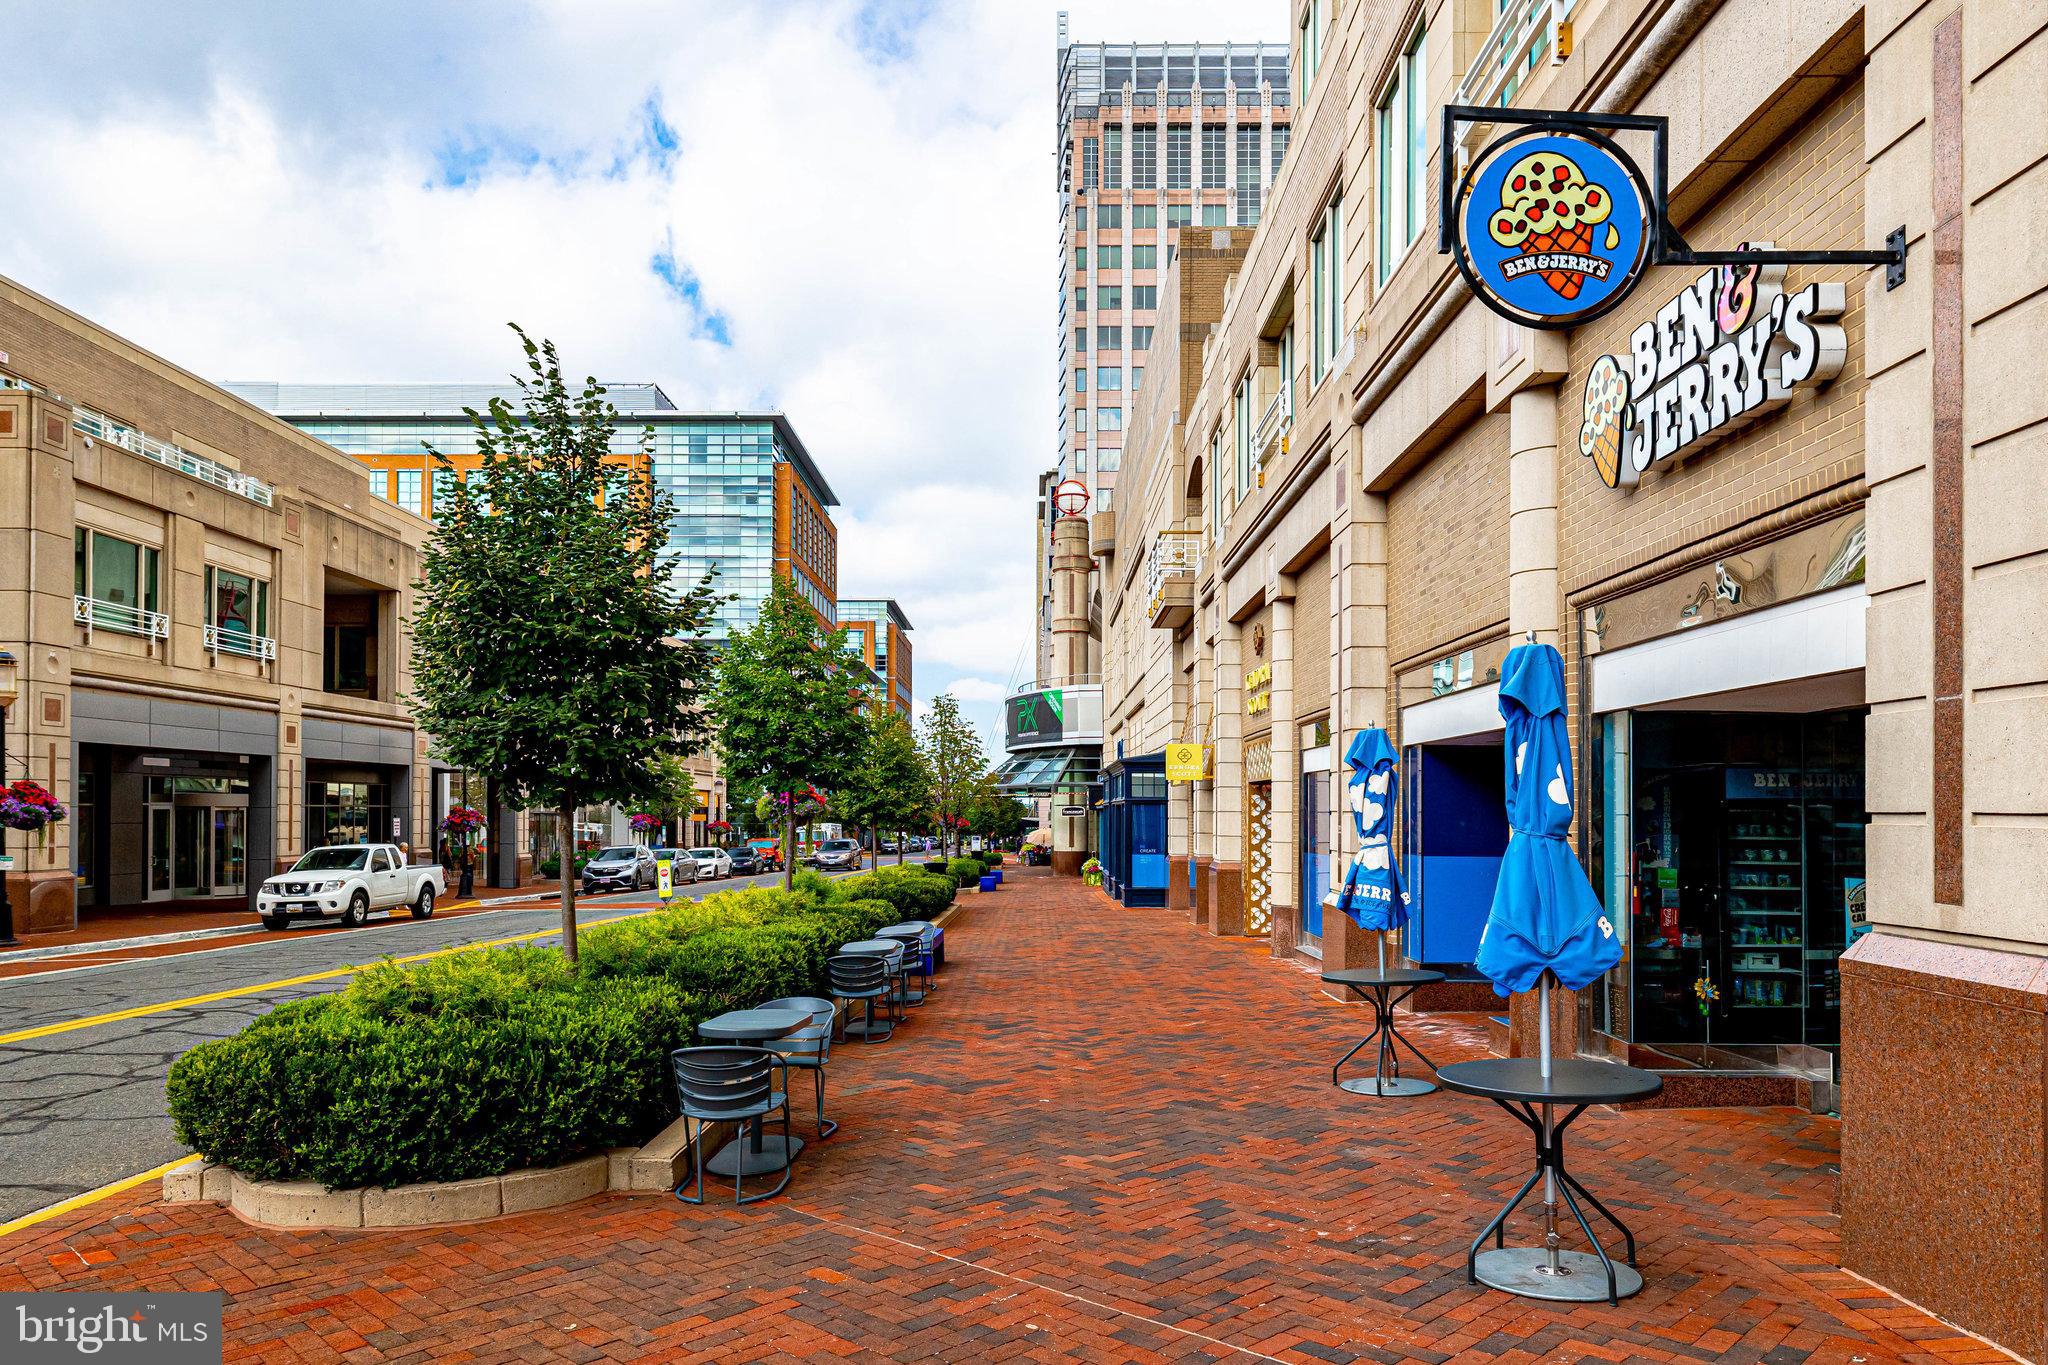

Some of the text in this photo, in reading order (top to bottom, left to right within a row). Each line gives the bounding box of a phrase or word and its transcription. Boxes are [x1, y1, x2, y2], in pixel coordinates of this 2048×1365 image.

[1630, 267, 1719, 401] BEN
[1631, 283, 1820, 473] JERRY'S
[1753, 773, 1791, 787] BEN
